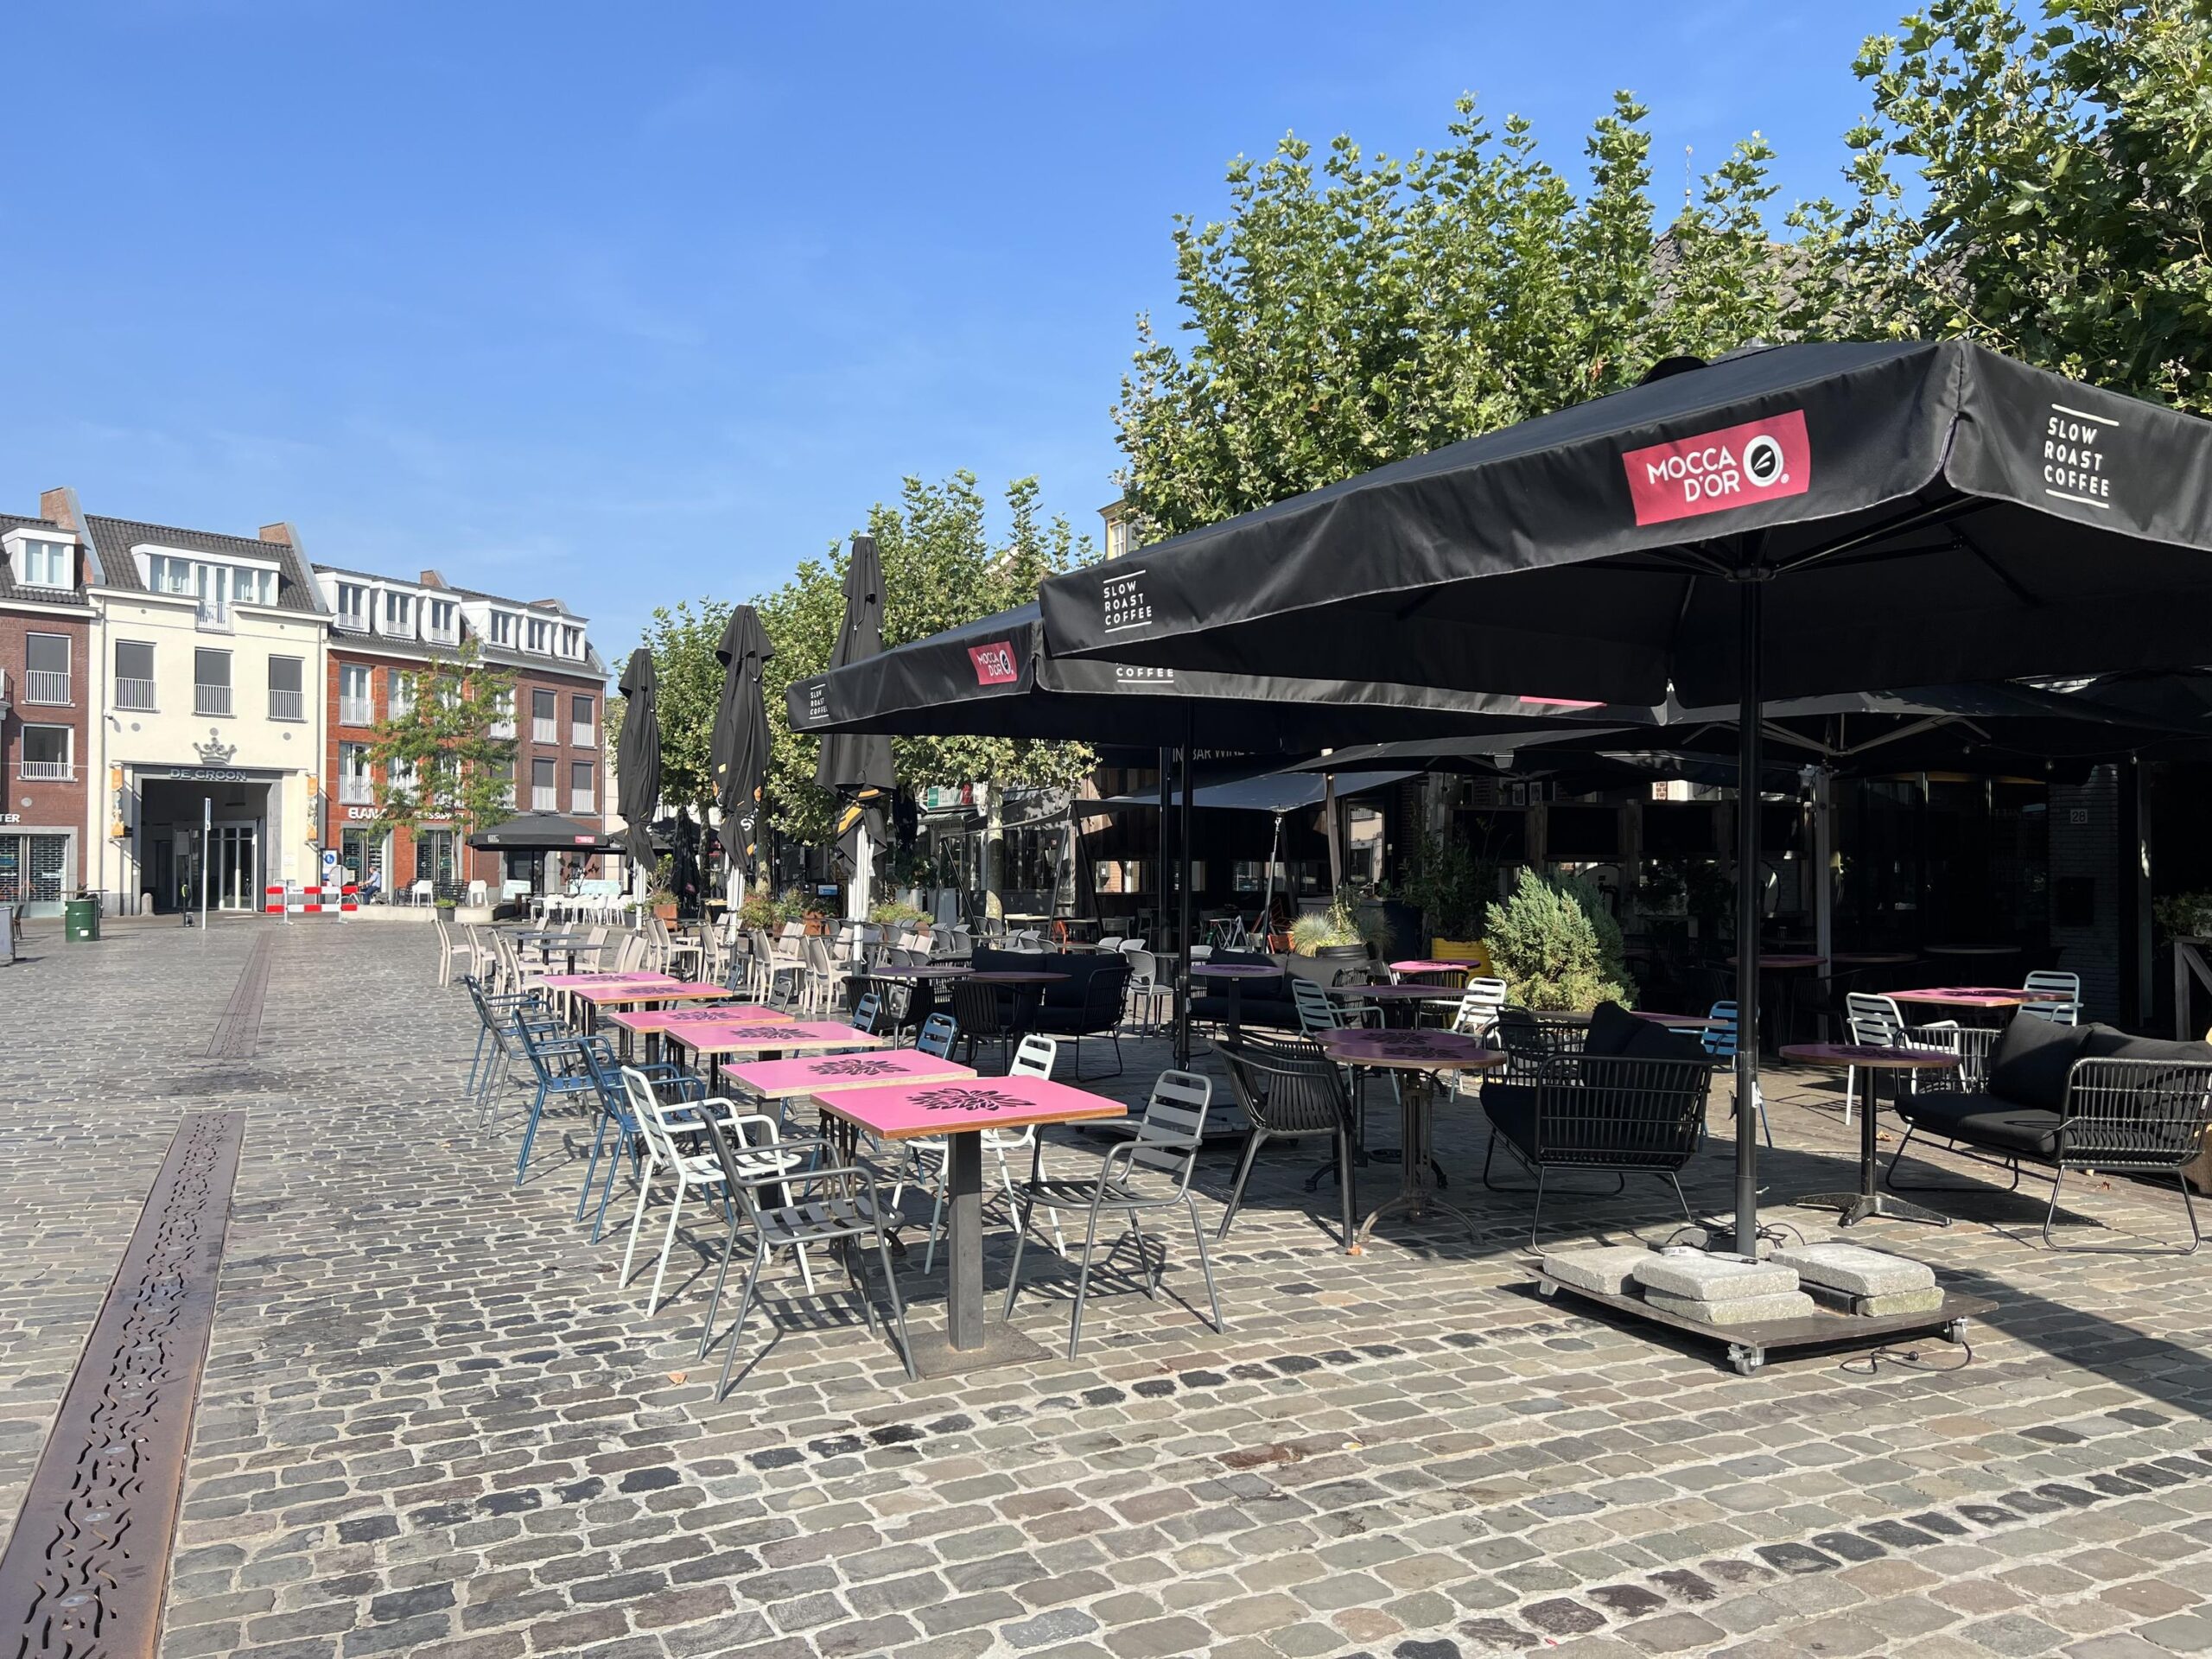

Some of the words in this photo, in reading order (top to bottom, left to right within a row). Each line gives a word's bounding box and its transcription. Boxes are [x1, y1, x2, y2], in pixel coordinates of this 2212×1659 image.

[2047, 416, 2098, 445] SLOW
[1646, 444, 1738, 485] MOCCA
[2044, 440, 2103, 471] ROAST
[1684, 468, 1741, 503] D'OR
[2044, 465, 2110, 497] COFFEE
[1103, 581, 1137, 599] SLOW
[1104, 593, 1145, 613] ROAST
[1105, 606, 1153, 626] COFFEE
[976, 652, 1000, 665] MOCCA
[1116, 667, 1174, 677] COFFEE
[170, 768, 191, 779] DE
[194, 770, 247, 781] CROON
[2072, 810, 2086, 822] 28
